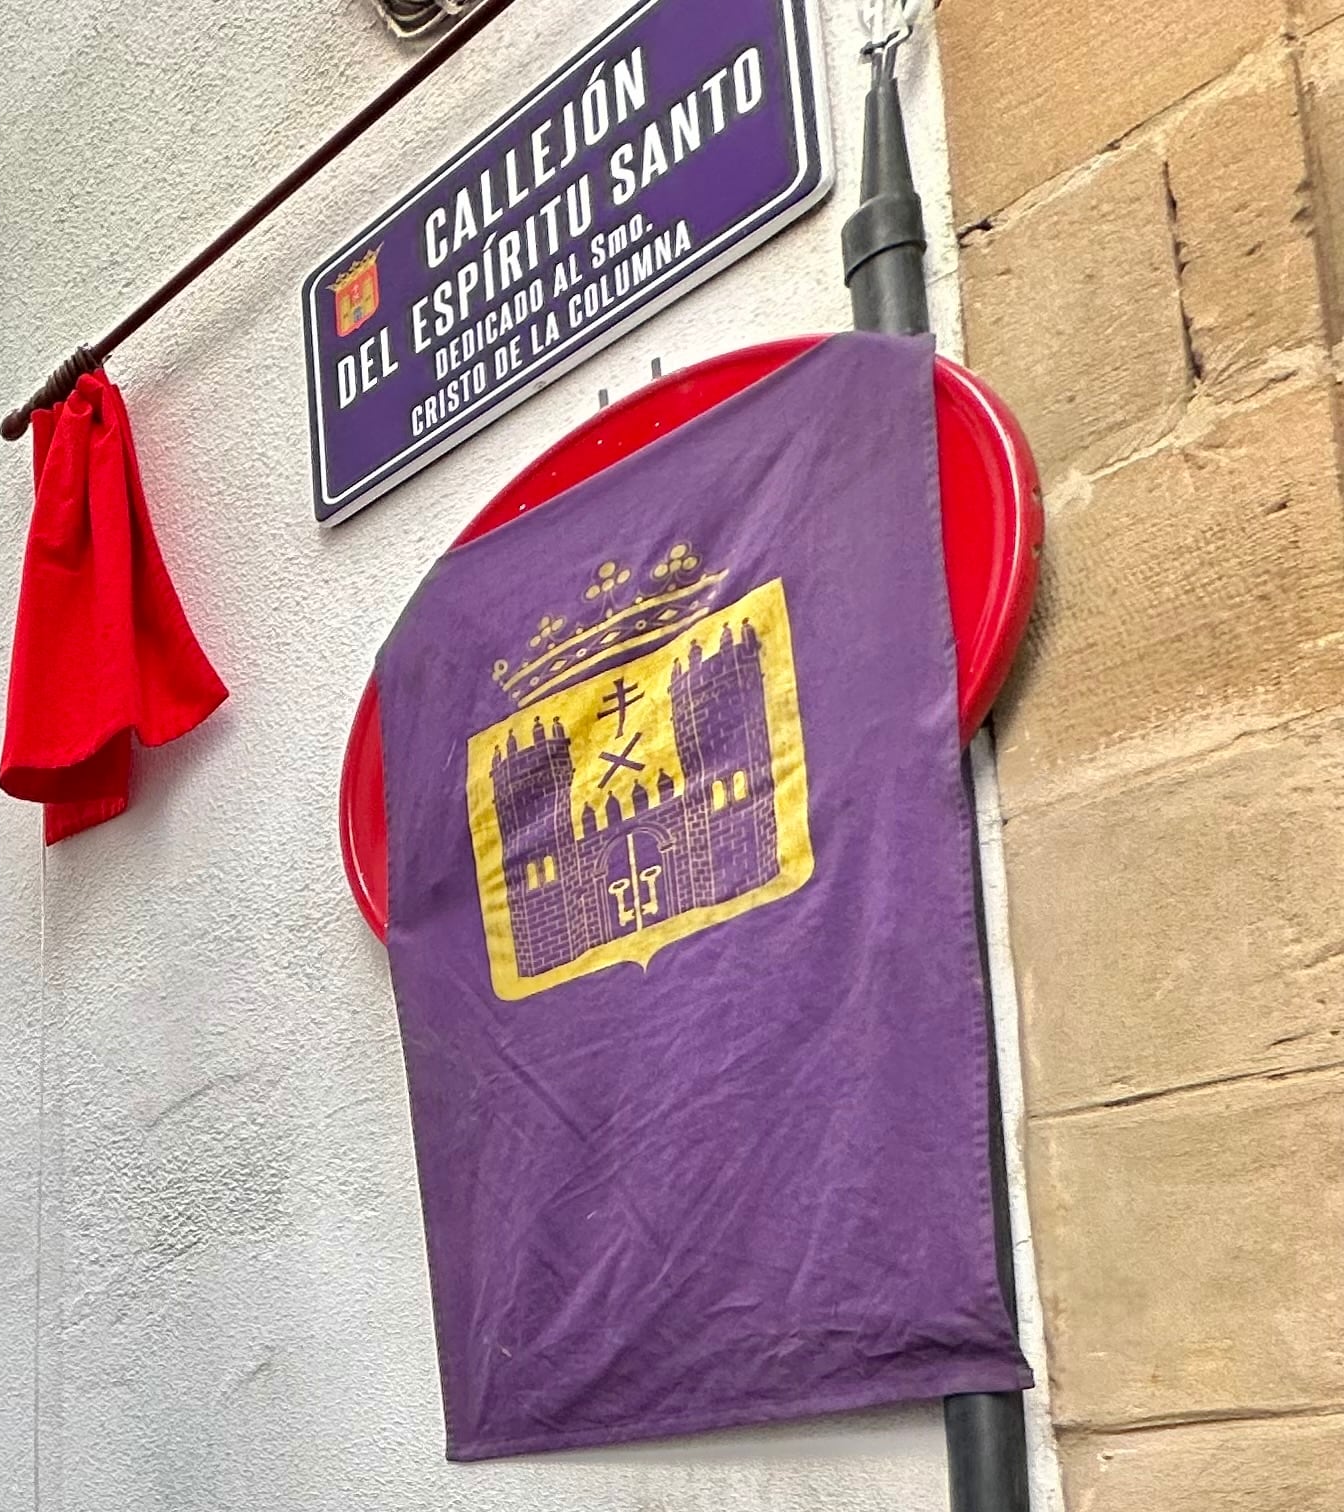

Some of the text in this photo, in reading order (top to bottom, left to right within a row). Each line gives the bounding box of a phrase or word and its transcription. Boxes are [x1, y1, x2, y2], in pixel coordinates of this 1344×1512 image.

[337, 46, 763, 410] DEL ESPÍRITU SANTO
[424, 46, 647, 270] CALLEJÓN
[411, 219, 692, 437] CRISTO DE LA COLUMNA
[434, 278, 544, 381] DEDICADO
[552, 252, 583, 298] AL
